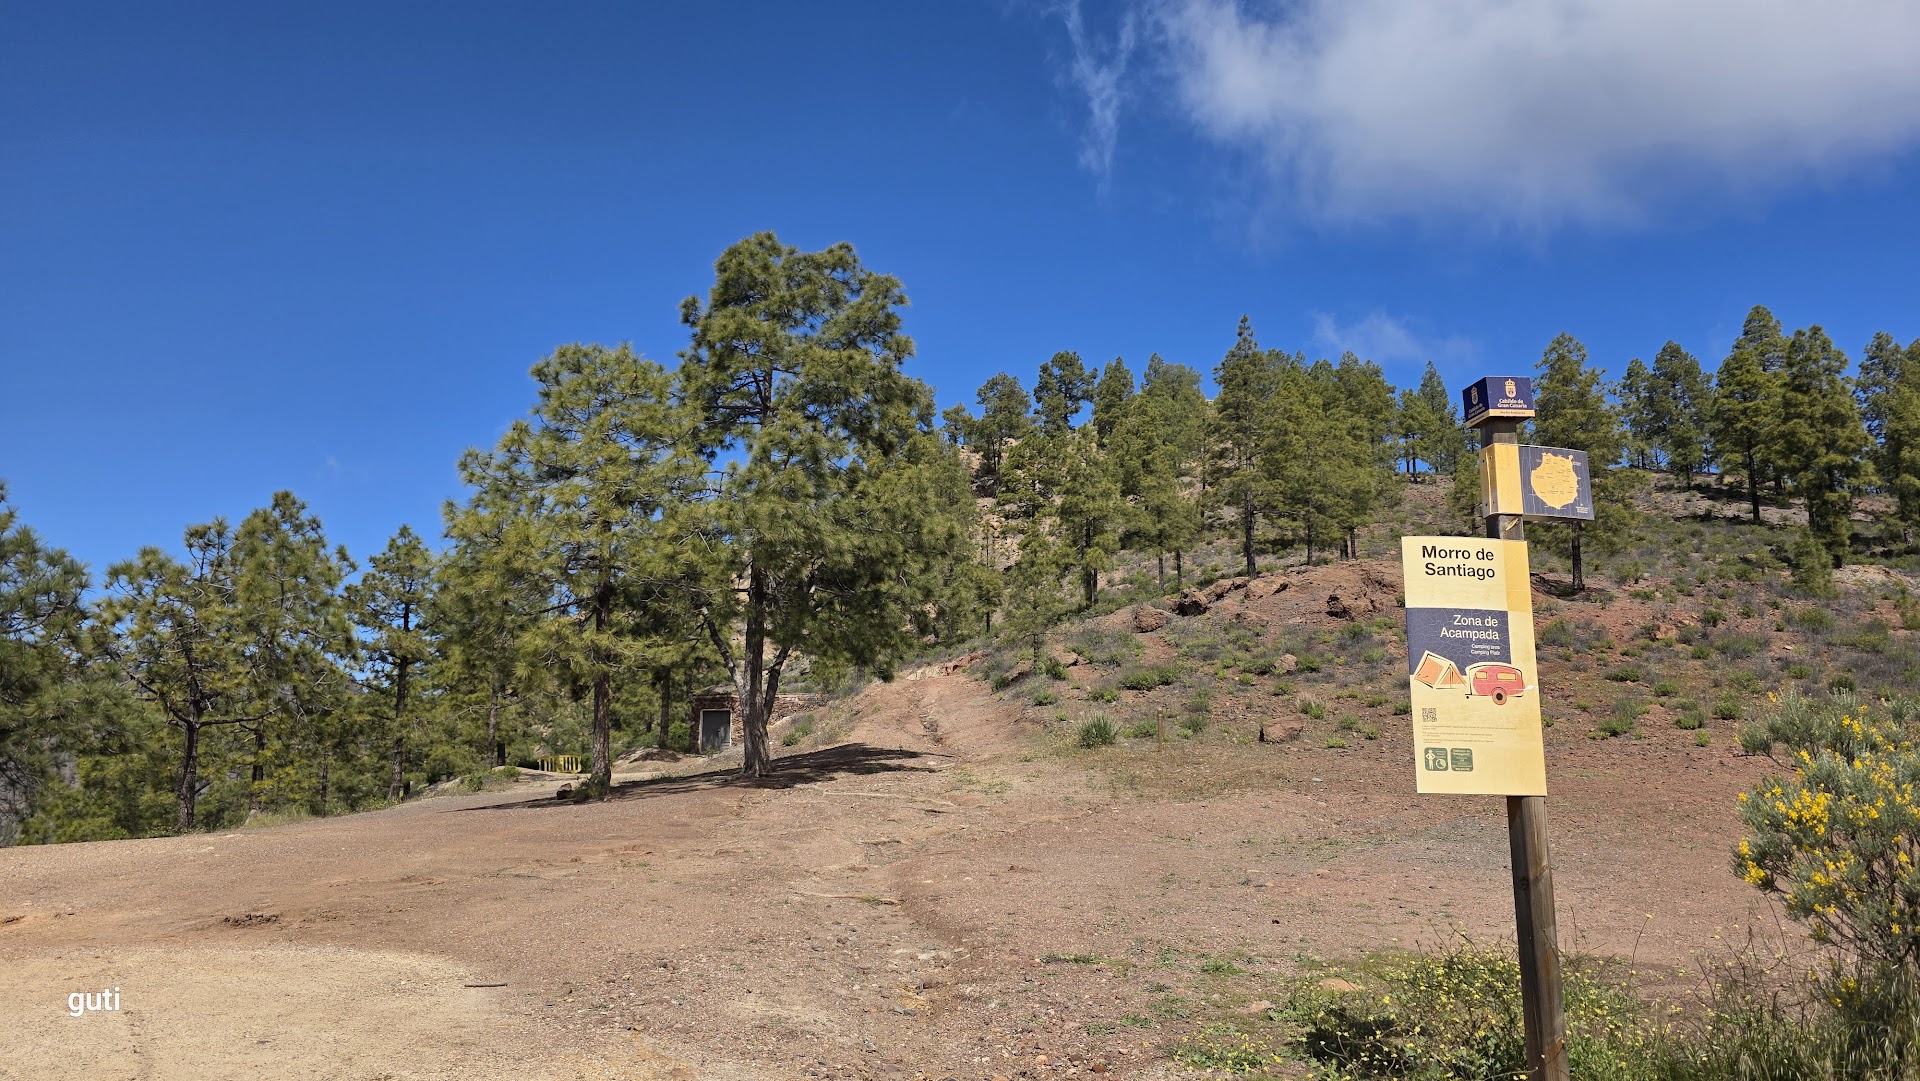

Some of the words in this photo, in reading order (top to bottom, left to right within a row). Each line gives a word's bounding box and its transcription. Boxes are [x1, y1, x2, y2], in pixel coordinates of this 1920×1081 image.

[1422, 546, 1470, 560] Morro
[1476, 548, 1494, 560] de
[1425, 562, 1495, 580] Santiago
[1454, 615, 1482, 626] Zona
[1485, 616, 1498, 626] de
[1440, 627, 1499, 641] Acampada
